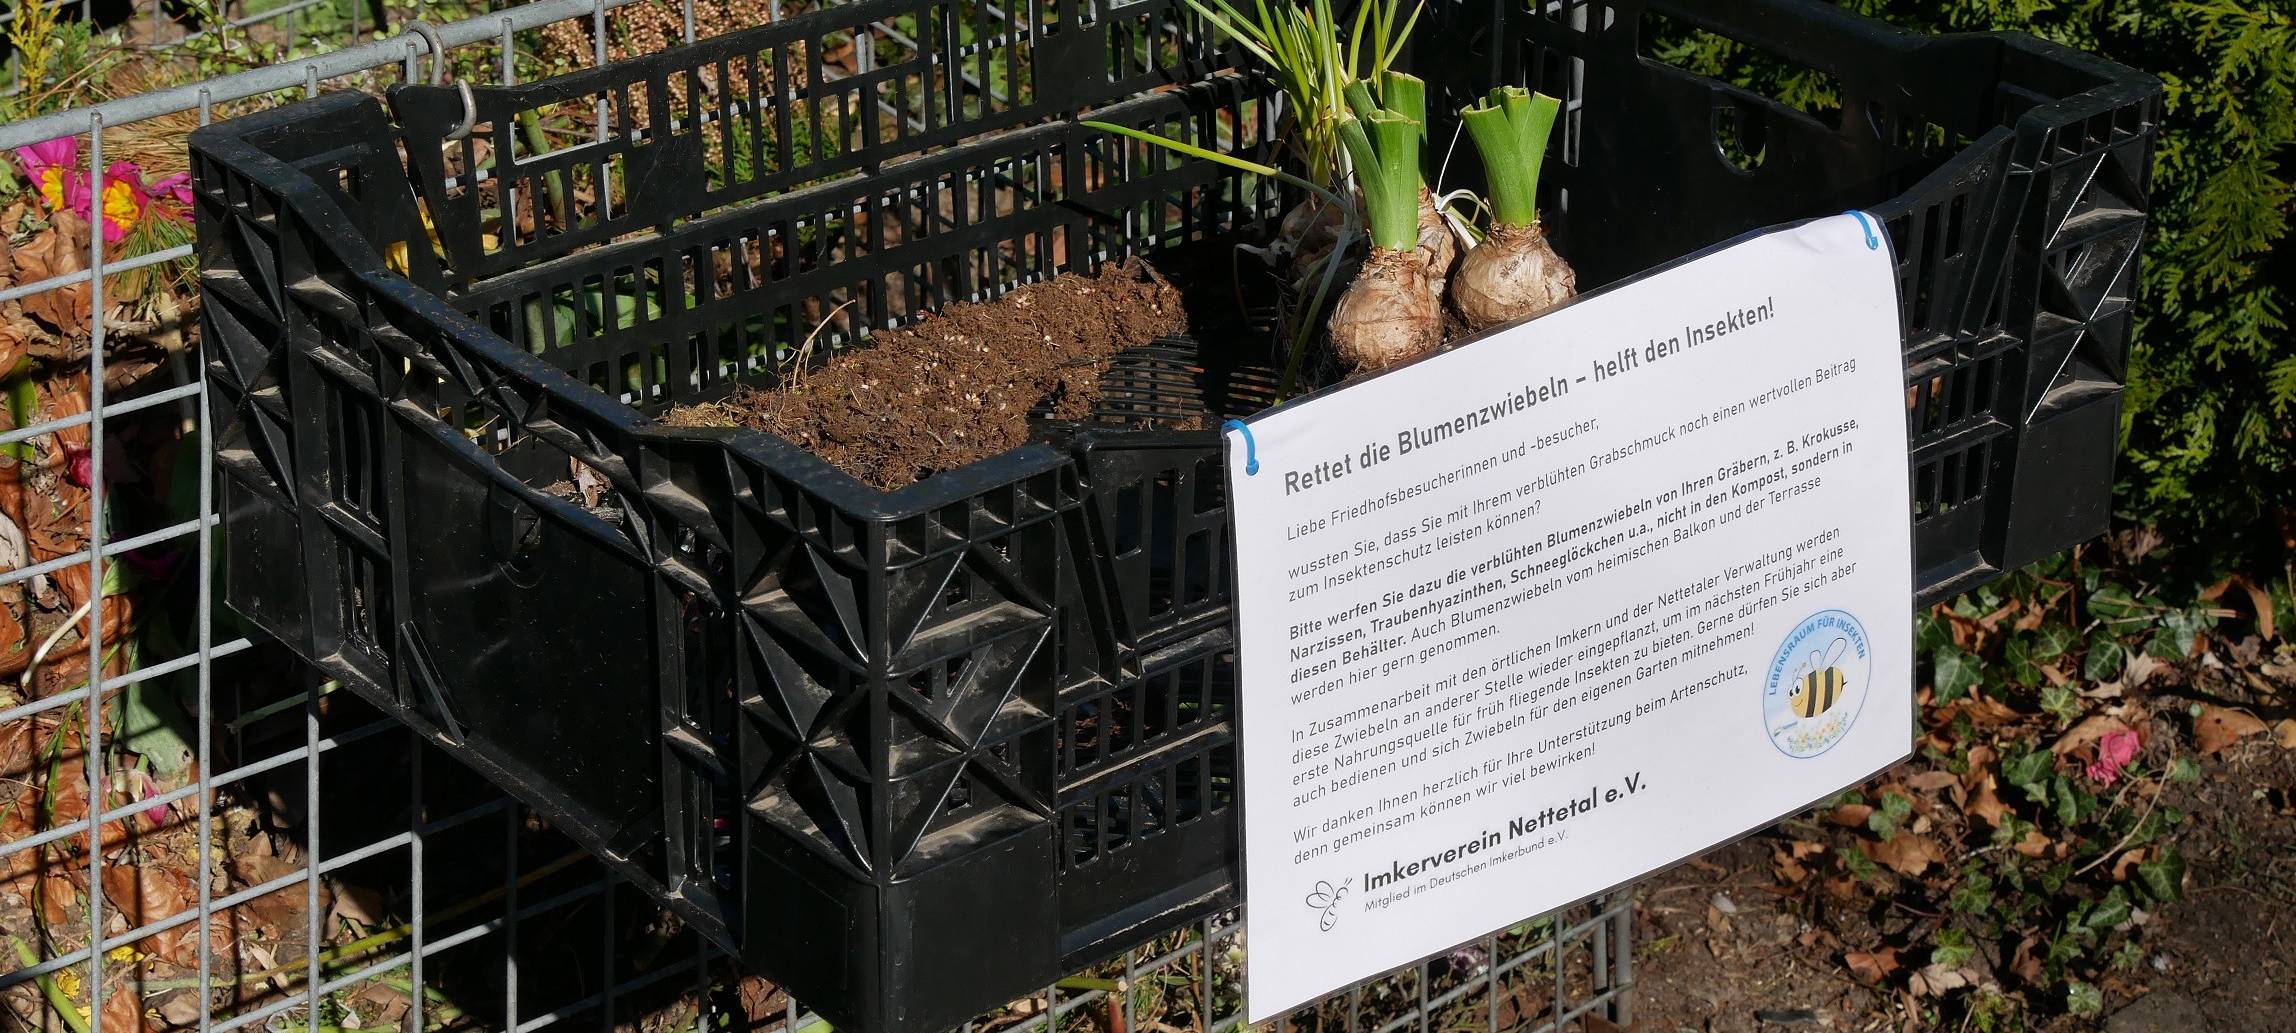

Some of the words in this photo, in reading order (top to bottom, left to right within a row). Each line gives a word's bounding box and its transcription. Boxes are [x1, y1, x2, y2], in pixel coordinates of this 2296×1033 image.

[1285, 454, 1352, 496] Rettet
[1360, 442, 1390, 469] die
[1398, 376, 1568, 455] Blumenzwiebeln
[1593, 348, 1638, 382] helft
[1645, 337, 1680, 363] den
[1686, 296, 1774, 348] Insekten!
[1288, 550, 1348, 580] wussten
[1354, 540, 1379, 556] Sie,
[1384, 526, 1417, 546] dass
[1421, 516, 1442, 533] Sie
[1447, 505, 1468, 524] mit
[1473, 491, 1512, 515] Ihrem
[1516, 463, 1585, 498] verblühten
[1590, 426, 1676, 470] Grabschmuck
[1680, 413, 1708, 436] noch
[1713, 402, 1745, 422] einen
[1749, 377, 1812, 408] wertvollen
[1816, 358, 1856, 383] Beitrag
[1288, 519, 1326, 541] Liebe
[1331, 456, 1497, 525] Friedhofsbesucherinnen
[1502, 441, 1525, 463] und
[1530, 418, 1599, 450] -besucher,
[1289, 583, 1318, 602] zum
[1324, 543, 1432, 590] Insektenschutz
[1436, 525, 1482, 550] leisten
[1487, 499, 1541, 532] können?
[1290, 620, 1322, 640] Bitte
[1327, 601, 1377, 626] werfen
[1382, 591, 1404, 608] Sie
[1409, 578, 1441, 598] dazu
[1447, 569, 1466, 585] die
[1470, 542, 1542, 576] verblühten
[1547, 498, 1652, 548] Blumenzwiebeln
[1656, 490, 1677, 506] von
[1682, 475, 1713, 496] Ihren
[1718, 455, 1770, 481] Gräbern,
[1773, 449, 1783, 460] z.
[1787, 440, 1798, 455] B.
[1802, 419, 1859, 449] Krokusse,
[1290, 628, 1366, 662] Narzissen,
[1370, 579, 1506, 633] Traubenhyazinthen,
[1510, 532, 1624, 584] Schneeglöckchen
[1628, 524, 1653, 539] u.a.,
[1657, 505, 1687, 528] nicht
[1690, 501, 1701, 515] in
[1706, 492, 1727, 508] den
[1731, 467, 1788, 498] Kompost,
[1791, 448, 1839, 475] sondern
[1842, 441, 1853, 454] in
[1291, 659, 1336, 684] diesen
[1342, 635, 1406, 665] Behälter.
[1411, 619, 1446, 642] Auch
[1451, 578, 1562, 628] Blumenzwiebeln
[1566, 566, 1593, 584] vom
[1597, 537, 1669, 573] heimischen
[1673, 518, 1715, 543] Balkon
[1720, 504, 1741, 525] und
[1746, 498, 1765, 514] der
[1768, 477, 1821, 505] Terrasse
[1291, 678, 1343, 705] werden
[1349, 666, 1377, 685] hier
[1382, 654, 1414, 677] gern
[1420, 625, 1500, 664] genommen.
[1292, 730, 1304, 743] In
[1309, 683, 1430, 737] Zusammenarbeit
[1436, 674, 1457, 692] mit
[1462, 666, 1486, 683] den
[1491, 642, 1551, 672] örtlichen
[1556, 623, 1601, 649] Imkern
[1606, 608, 1628, 629] und
[1633, 601, 1654, 618] der
[1658, 575, 1720, 609] Nettetaler
[1724, 547, 1792, 581] Verwaltung
[1796, 528, 1839, 553] werden
[1292, 743, 1329, 764] diese
[1334, 718, 1398, 749] Zwiebeln
[1404, 711, 1420, 725] an
[1425, 689, 1480, 717] anderer
[1484, 673, 1523, 696] Stelle
[1528, 655, 1574, 679] wieder
[1578, 620, 1659, 661] eingepflanzt,
[1663, 612, 1682, 628] um
[1686, 605, 1701, 619] im
[1705, 581, 1760, 611] nächsten
[1764, 558, 1816, 587] Frühjahr
[1820, 548, 1843, 565] eine
[1293, 764, 1328, 786] erste
[1335, 721, 1448, 770] Nahrungsquelle
[1453, 713, 1472, 729] für
[1477, 700, 1504, 720] früh
[1509, 676, 1570, 708] fliegende
[1575, 654, 1629, 684] Insekten
[1634, 646, 1648, 661] zu
[1652, 630, 1693, 653] bieten.
[1697, 613, 1734, 635] Gerne
[1738, 596, 1777, 619] dürfen
[1782, 586, 1799, 601] Sie
[1804, 573, 1827, 593] sich
[1831, 562, 1857, 581] aber
[1293, 784, 1326, 807] auch
[1331, 762, 1396, 792] bedienen
[1402, 747, 1426, 768] und
[1432, 737, 1459, 757] sich
[1465, 715, 1525, 746] Zwiebeln
[1530, 705, 1549, 722] für
[1553, 696, 1576, 713] den
[1581, 675, 1631, 702] eigenen
[1636, 656, 1677, 680] Garten
[1682, 622, 1754, 663] mitnehmen!
[1769, 622, 1815, 695] LEBENSRAUM
[1817, 616, 1835, 629] FÜR
[1837, 618, 1865, 659] INSEKTEN
[1293, 826, 1317, 843] Wir
[1322, 806, 1373, 832] danken
[1379, 791, 1417, 813] Ihnen
[1423, 766, 1478, 797] herzlich
[1483, 758, 1502, 775] für
[1507, 748, 1533, 766] Ihre
[1538, 711, 1631, 754] Unterstützung
[1636, 697, 1666, 717] beim
[1670, 665, 1748, 703] Artenschutz,
[1294, 844, 1328, 864] denn
[1333, 812, 1415, 853] gemeinsam
[1420, 792, 1470, 818] können
[1476, 781, 1498, 797] wir
[1502, 768, 1526, 788] viel
[1530, 742, 1595, 778] bewirken!
[1364, 830, 1501, 893] Imkerverein
[1509, 786, 1597, 840] Nettetal
[1605, 771, 1646, 803] e.V.
[1365, 886, 1410, 912] Mitglied
[1414, 884, 1426, 894] im
[1430, 862, 1486, 889] Deutschen
[1490, 837, 1544, 866] Imkerbund
